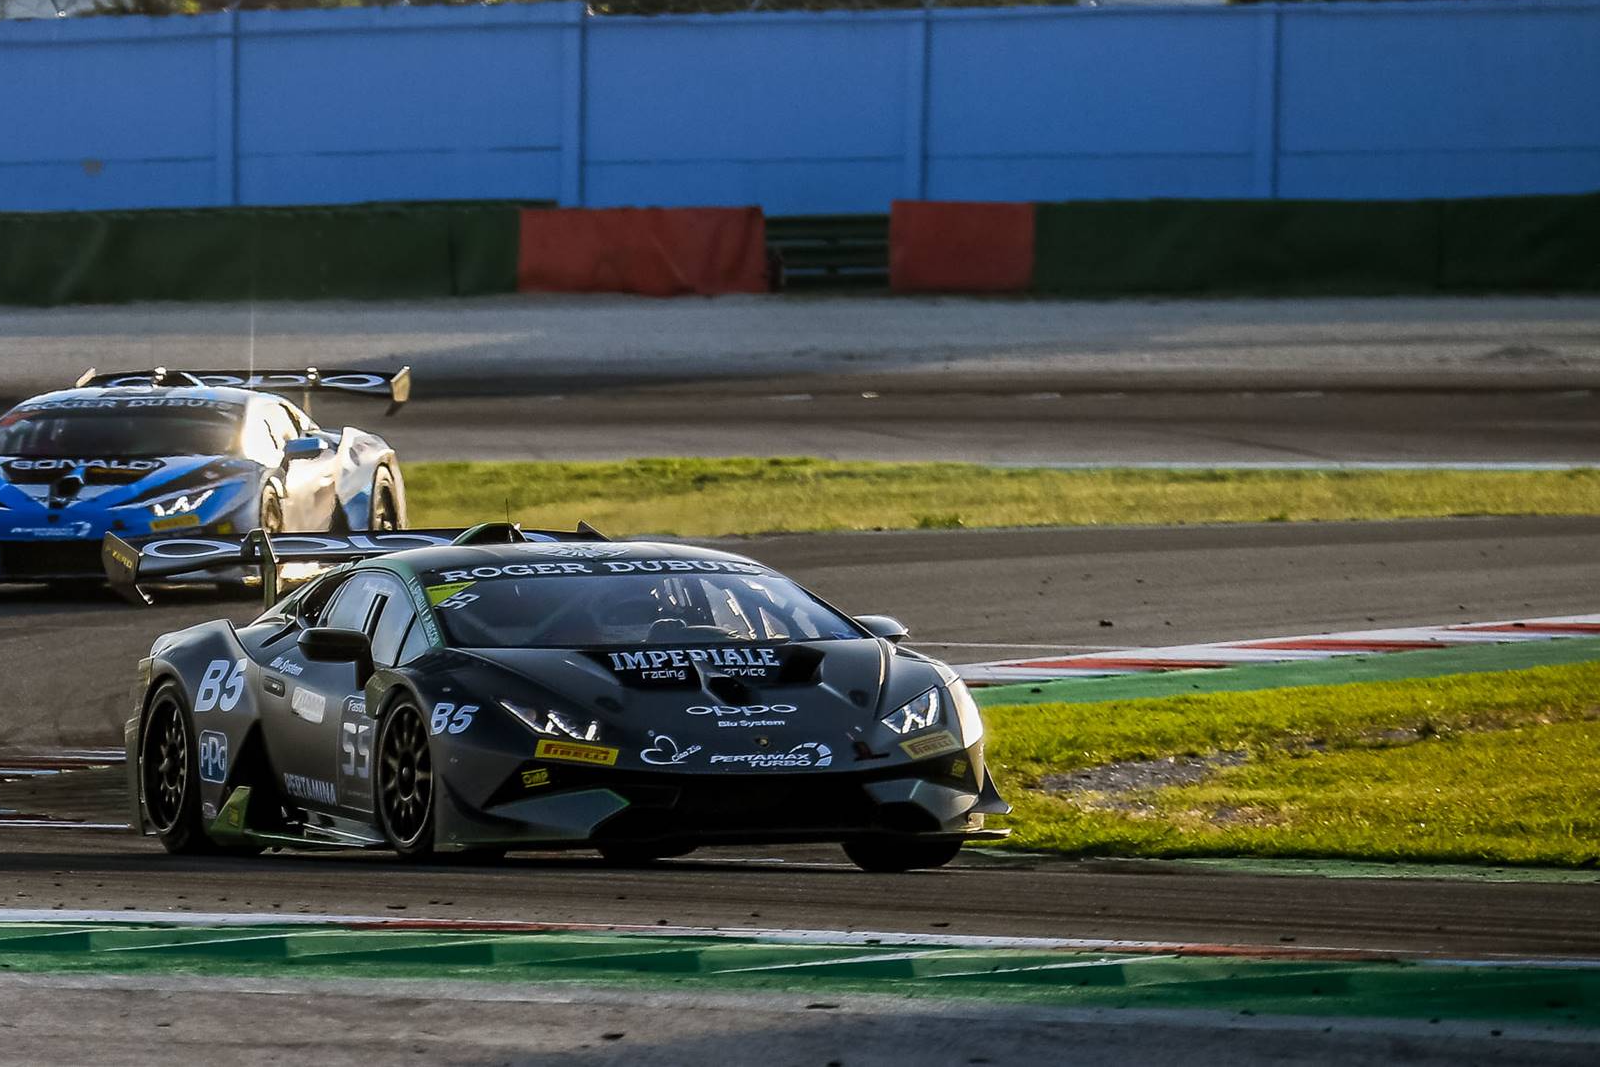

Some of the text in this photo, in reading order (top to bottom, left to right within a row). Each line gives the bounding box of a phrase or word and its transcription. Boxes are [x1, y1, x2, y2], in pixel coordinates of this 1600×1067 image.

[440, 559, 765, 583] ROGER DUBUIS
[642, 667, 687, 680] racing
[194, 658, 248, 712] B5
[431, 702, 480, 735] B5
[685, 704, 799, 717] oppo
[739, 719, 786, 729] System
[201, 737, 227, 776] PPG
[342, 722, 370, 779] 55
[543, 743, 610, 762] PIRELLI
[710, 754, 809, 764] PERTAMAX
[750, 759, 812, 768] TURBO
[283, 772, 338, 807] PERTAMINA
